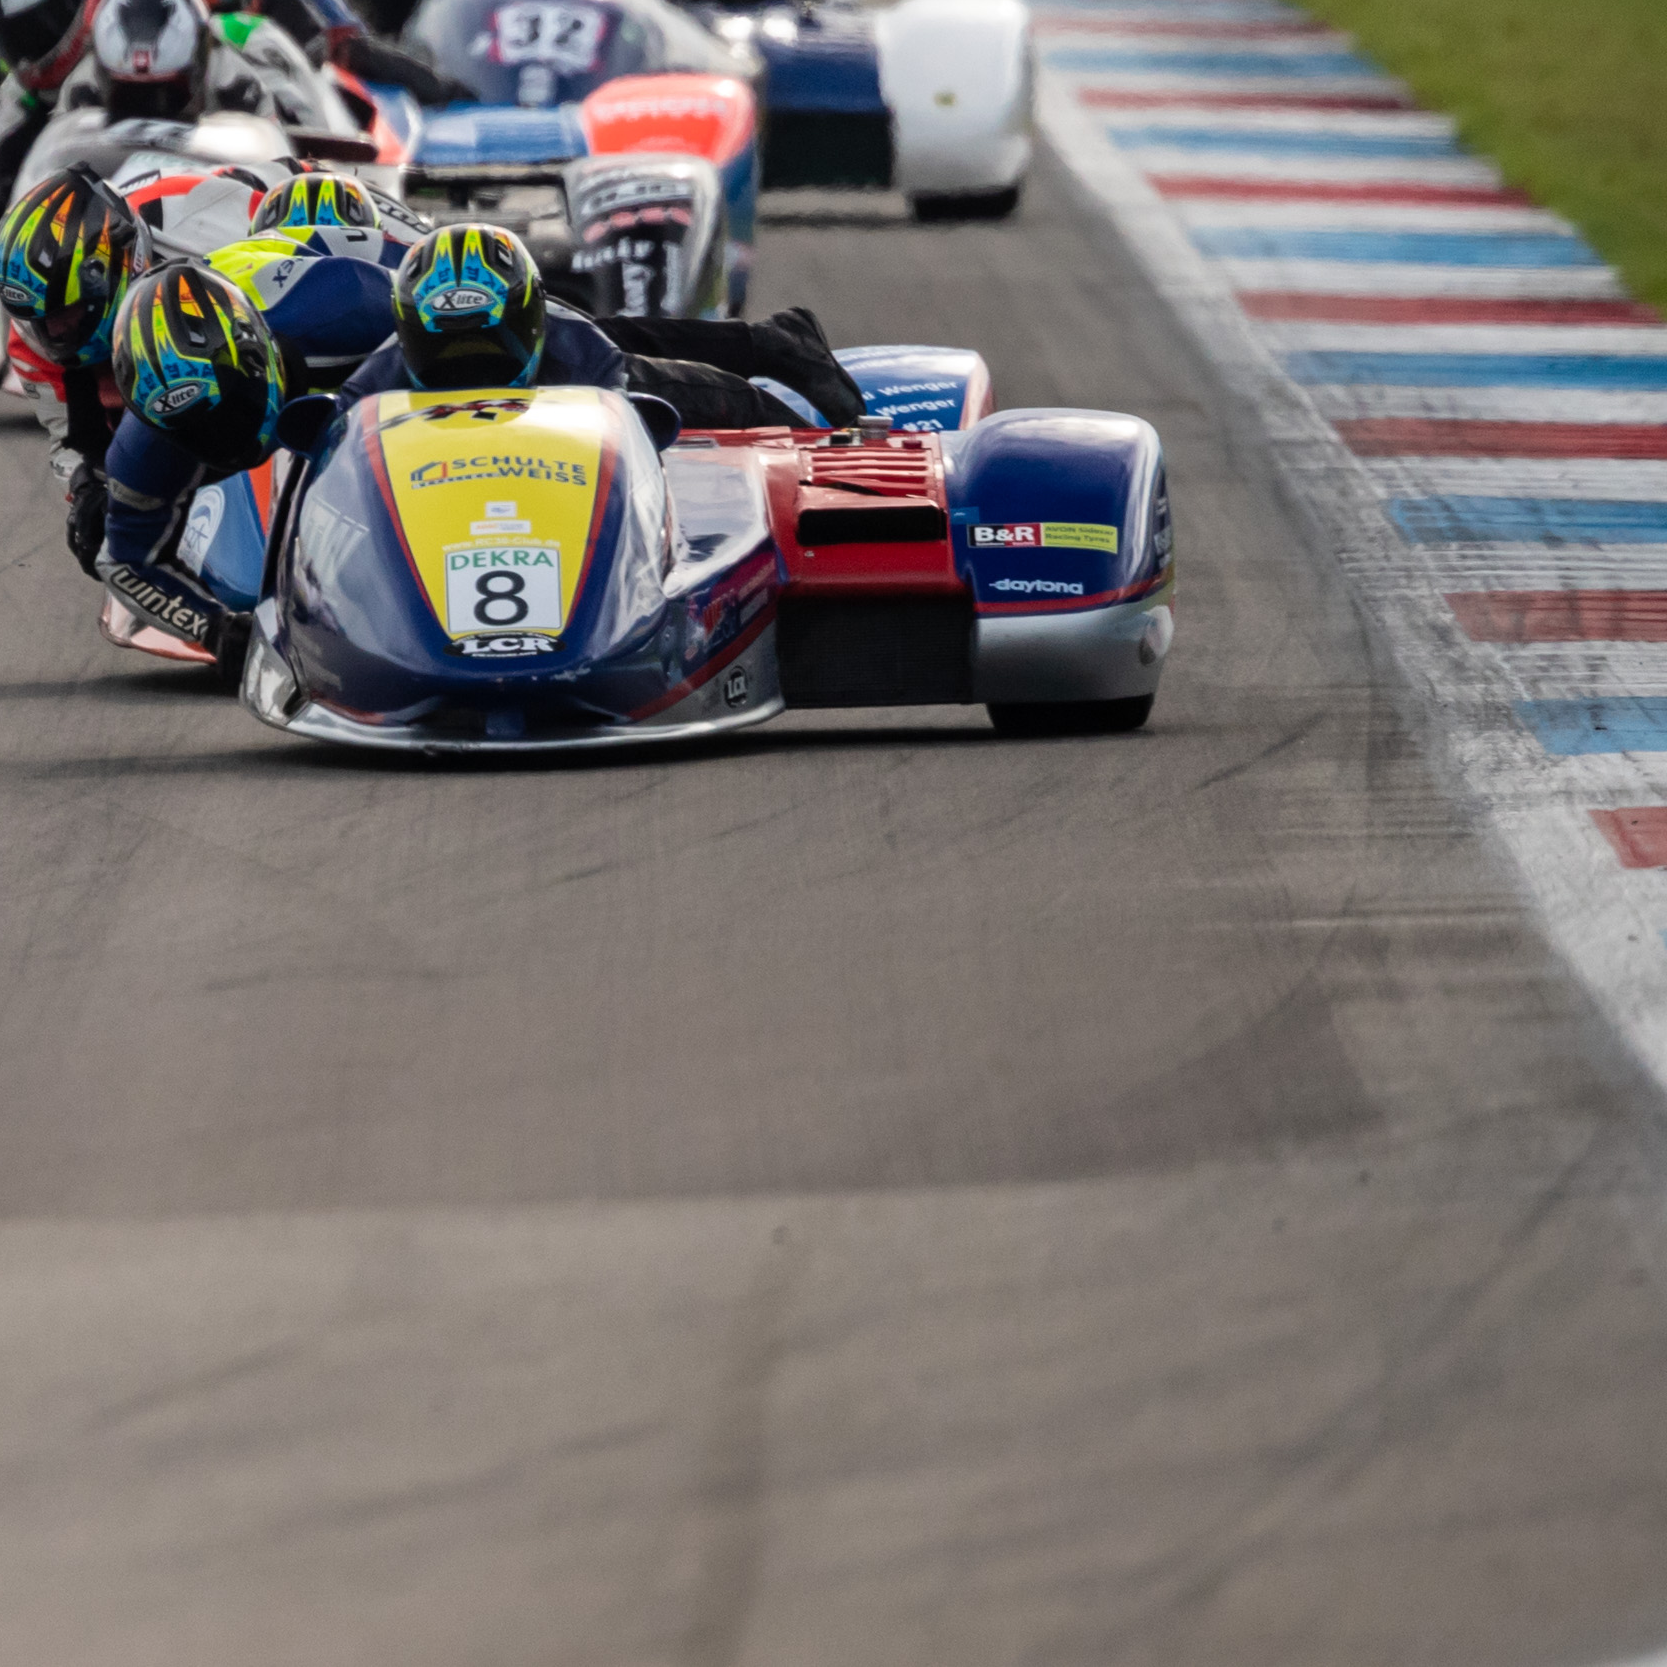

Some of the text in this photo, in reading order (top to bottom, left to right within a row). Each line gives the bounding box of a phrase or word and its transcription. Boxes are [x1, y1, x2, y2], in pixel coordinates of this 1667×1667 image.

[877, 381, 959, 397] Wenger
[875, 399, 956, 417] Wenger
[451, 456, 586, 474] SCHULTE
[497, 466, 587, 486] WEISS
[973, 525, 1035, 543] B&R
[450, 550, 555, 571] DEKRA
[989, 577, 1084, 595] daytona
[112, 568, 209, 636] wintex
[473, 569, 530, 626] 8
[461, 637, 555, 654] LCR
